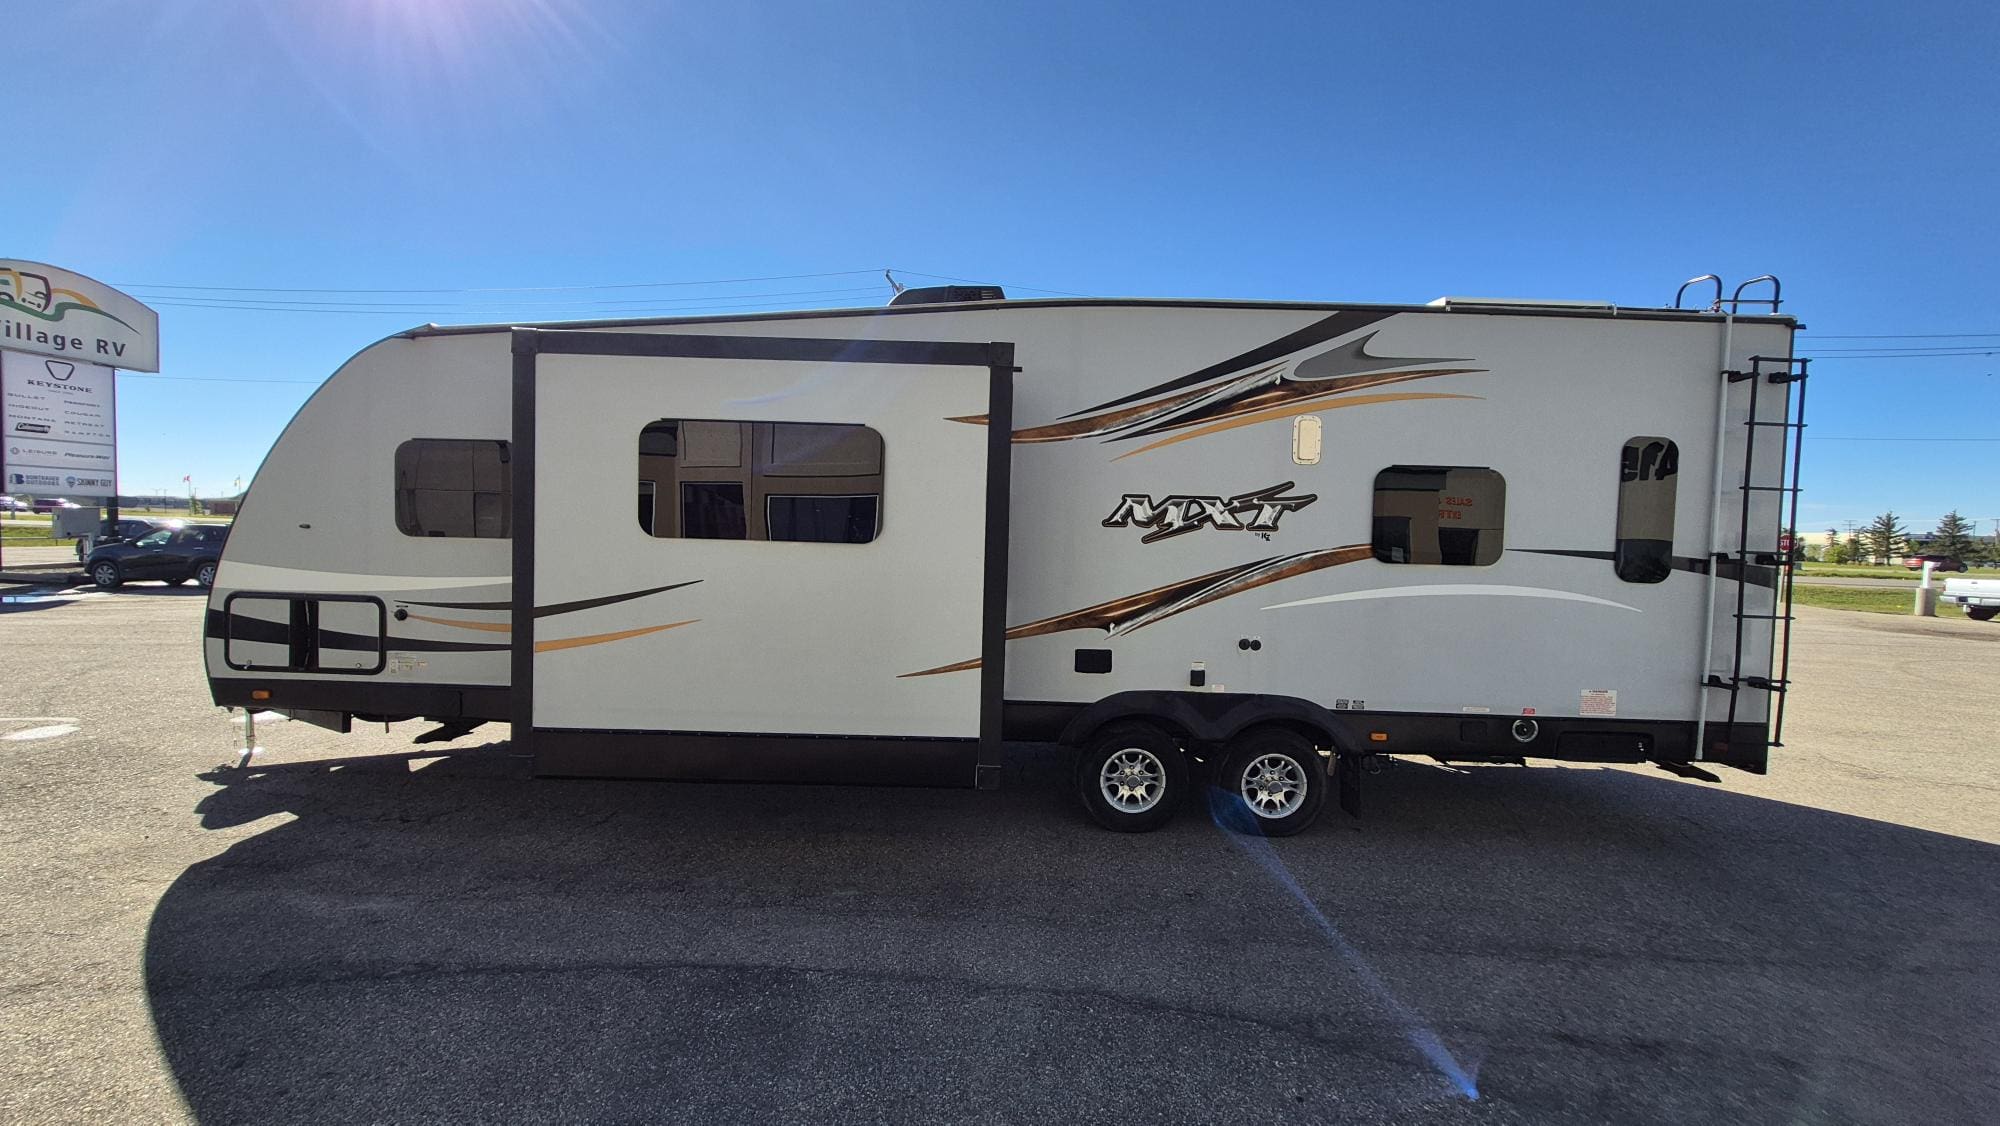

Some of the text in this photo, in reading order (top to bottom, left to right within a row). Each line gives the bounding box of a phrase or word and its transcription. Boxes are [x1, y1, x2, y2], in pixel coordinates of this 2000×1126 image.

[0, 320, 126, 357] illage RV
[26, 379, 93, 394] KEYSTONE
